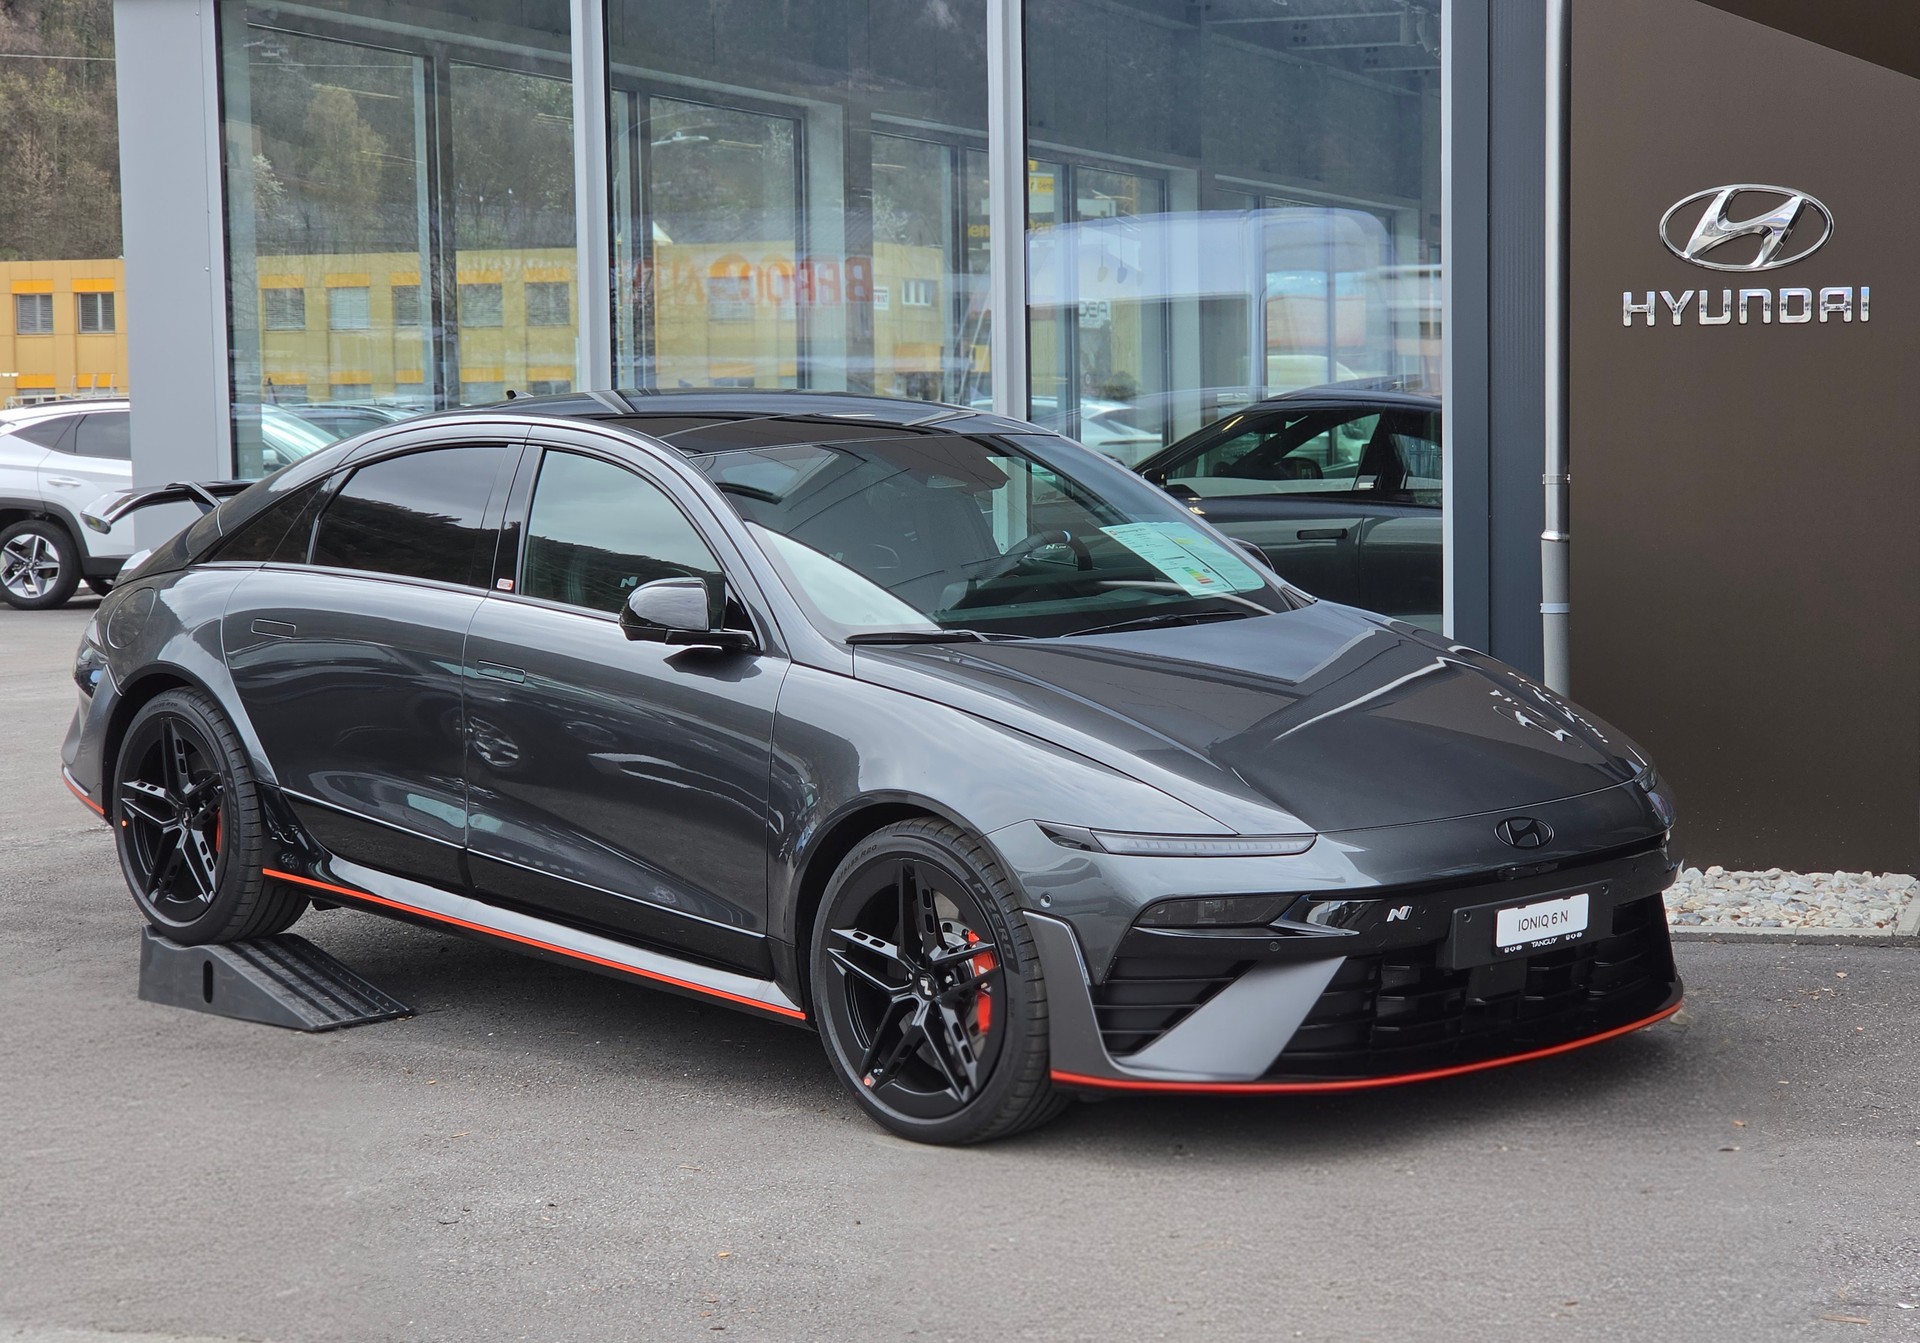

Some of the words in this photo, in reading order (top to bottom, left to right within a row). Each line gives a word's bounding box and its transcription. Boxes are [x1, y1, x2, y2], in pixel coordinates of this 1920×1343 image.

[1622, 286, 1871, 328] HYUNDAI
[1386, 905, 1413, 923] N
[1518, 914, 1549, 932] IONIQ
[1551, 912, 1558, 925] 6
[1560, 910, 1569, 923] N
[984, 898, 1015, 960] ZERO
[1530, 937, 1558, 948] TANGUY
